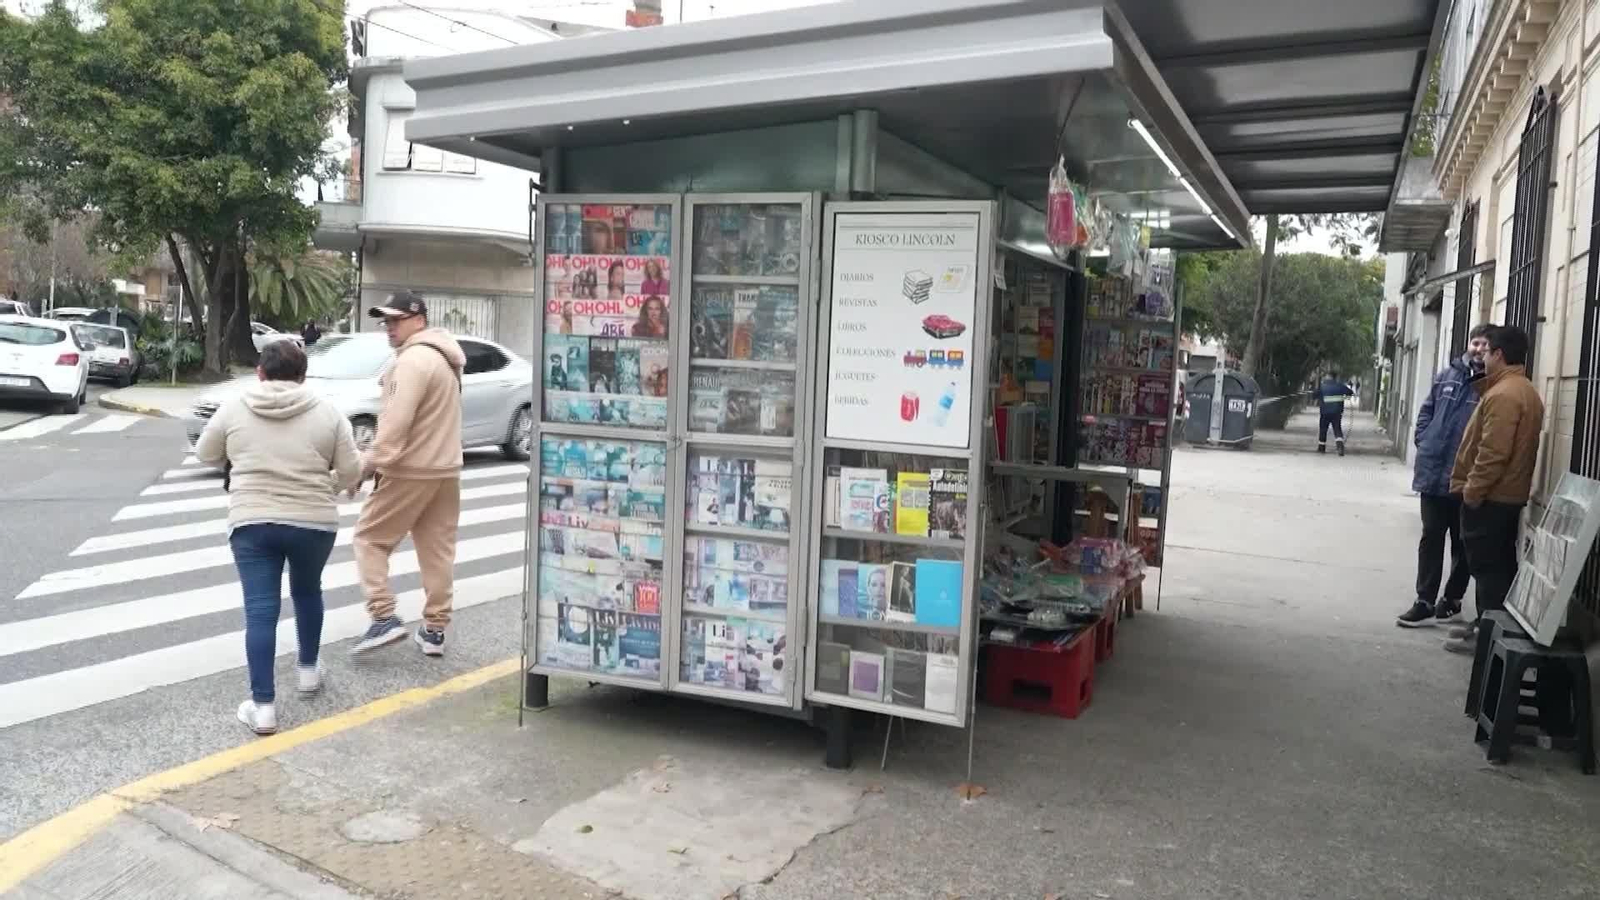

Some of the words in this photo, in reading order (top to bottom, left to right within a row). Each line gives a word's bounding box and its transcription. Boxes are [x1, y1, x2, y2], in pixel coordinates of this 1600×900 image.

[855, 232, 900, 247] KIOSCO
[902, 232, 956, 247] LINCOLN
[840, 271, 875, 282] DIARIOS
[838, 297, 878, 308] REVISTAS
[837, 321, 868, 333] LIBROS
[836, 346, 897, 359] COLECCIONES
[834, 371, 877, 382] JUGUETES
[834, 395, 870, 407] BEBIDAS
